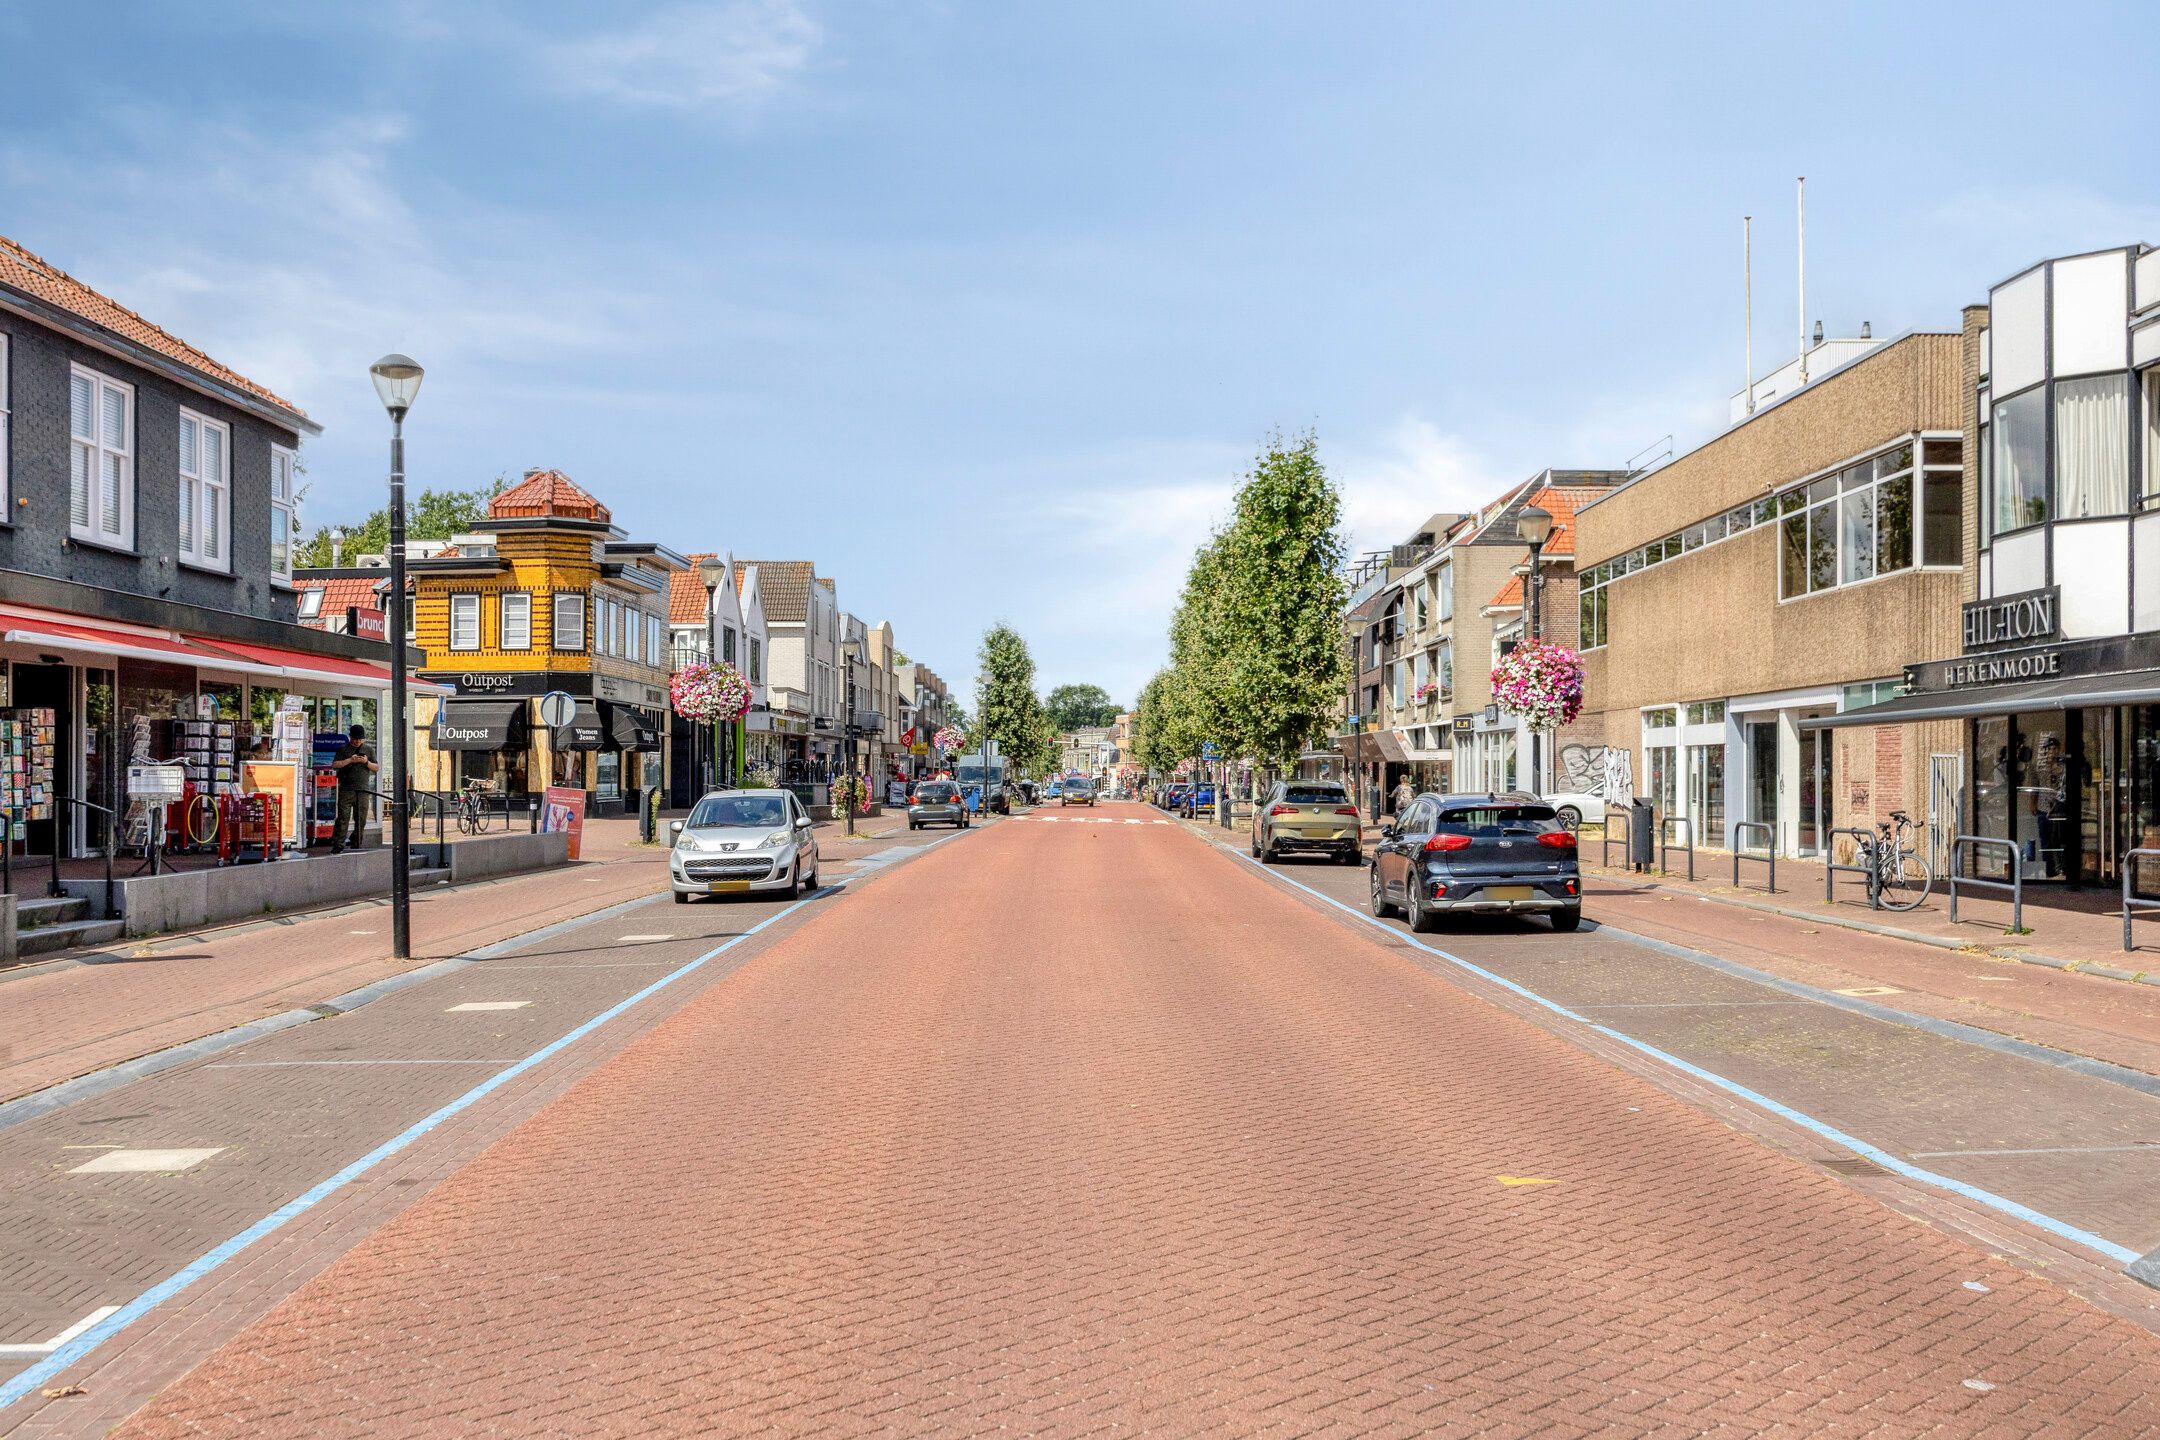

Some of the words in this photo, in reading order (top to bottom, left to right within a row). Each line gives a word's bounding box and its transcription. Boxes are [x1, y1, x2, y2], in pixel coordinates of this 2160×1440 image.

[1945, 653, 2060, 686] HERENMODE
[462, 673, 514, 690] Outpost
[446, 727, 489, 741] Outpost
